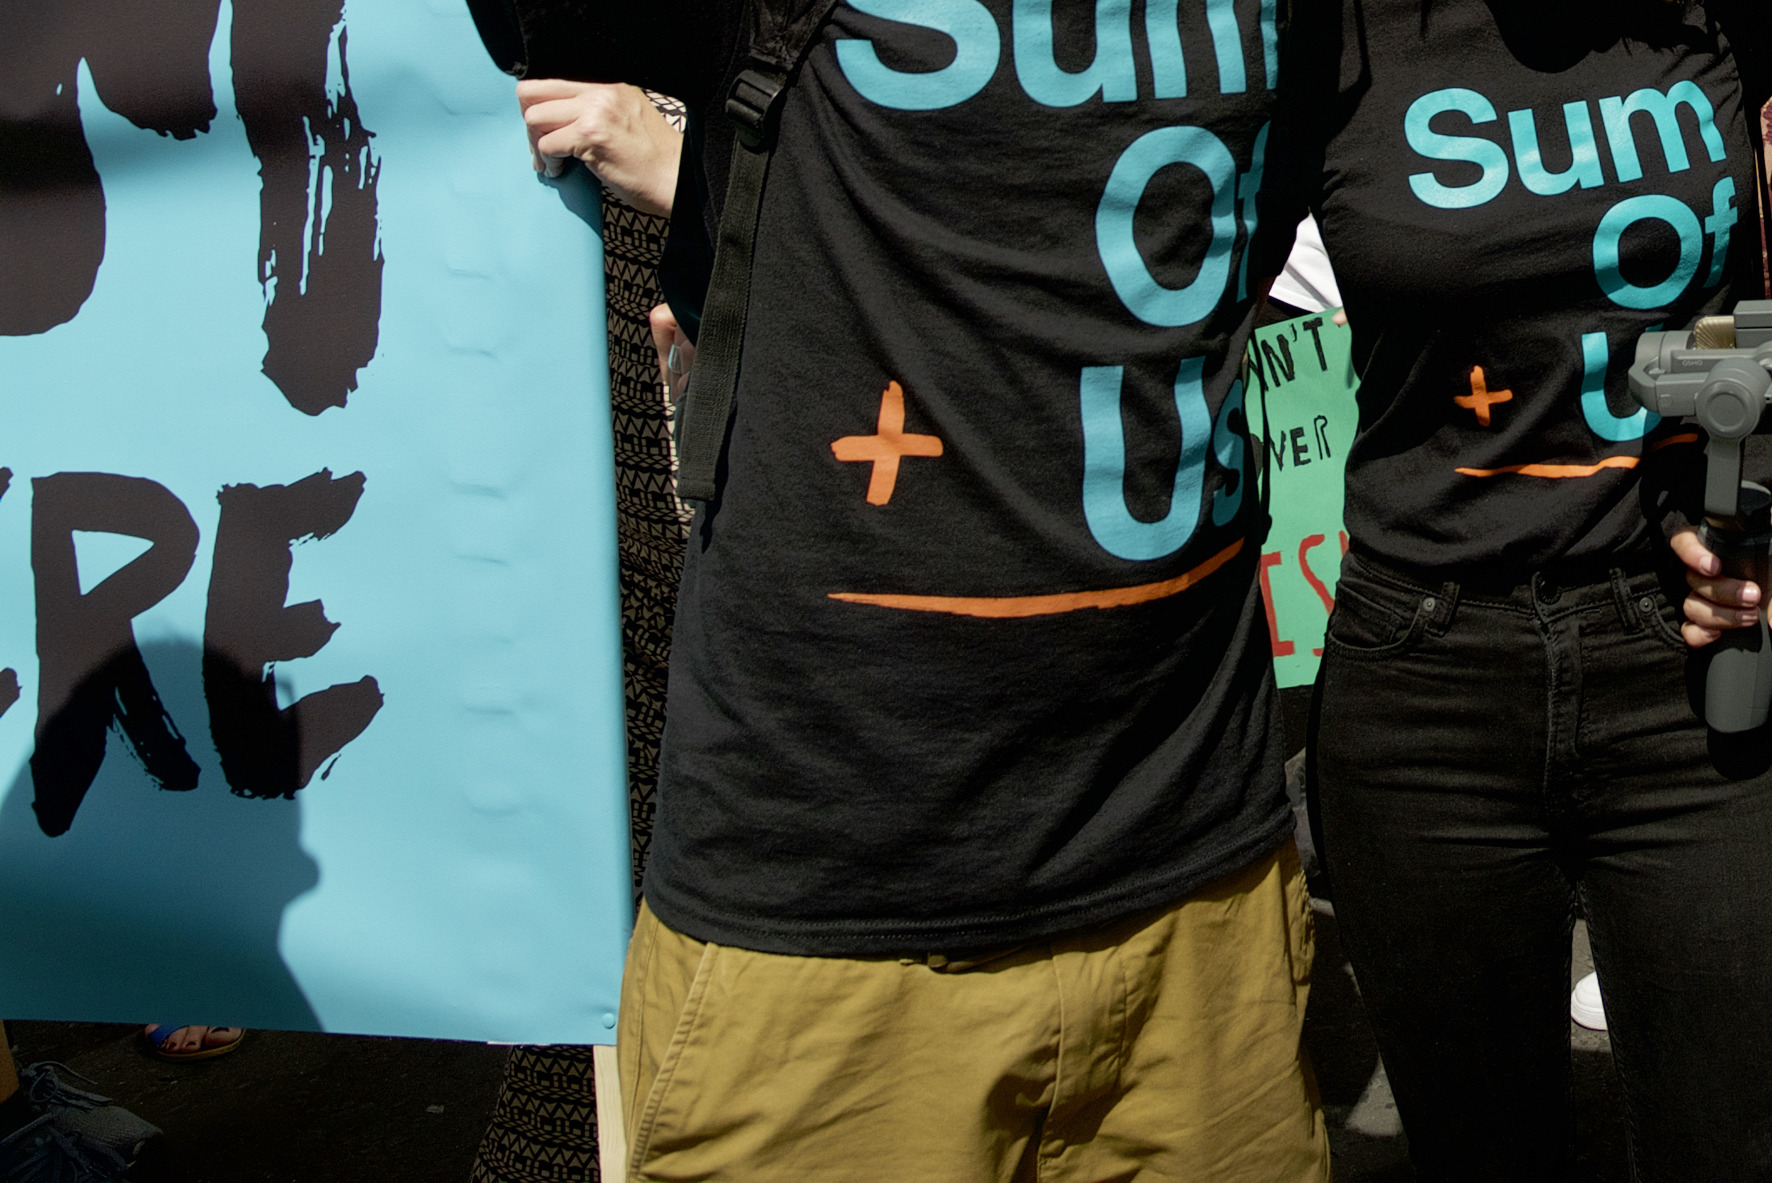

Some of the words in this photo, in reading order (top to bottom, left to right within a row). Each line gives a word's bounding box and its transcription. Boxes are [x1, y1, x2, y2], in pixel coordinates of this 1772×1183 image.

[1095, 119, 1272, 328] Of
[1403, 79, 1727, 210] Sum
[1592, 176, 1738, 310] Of
[1080, 356, 1244, 562] Us
